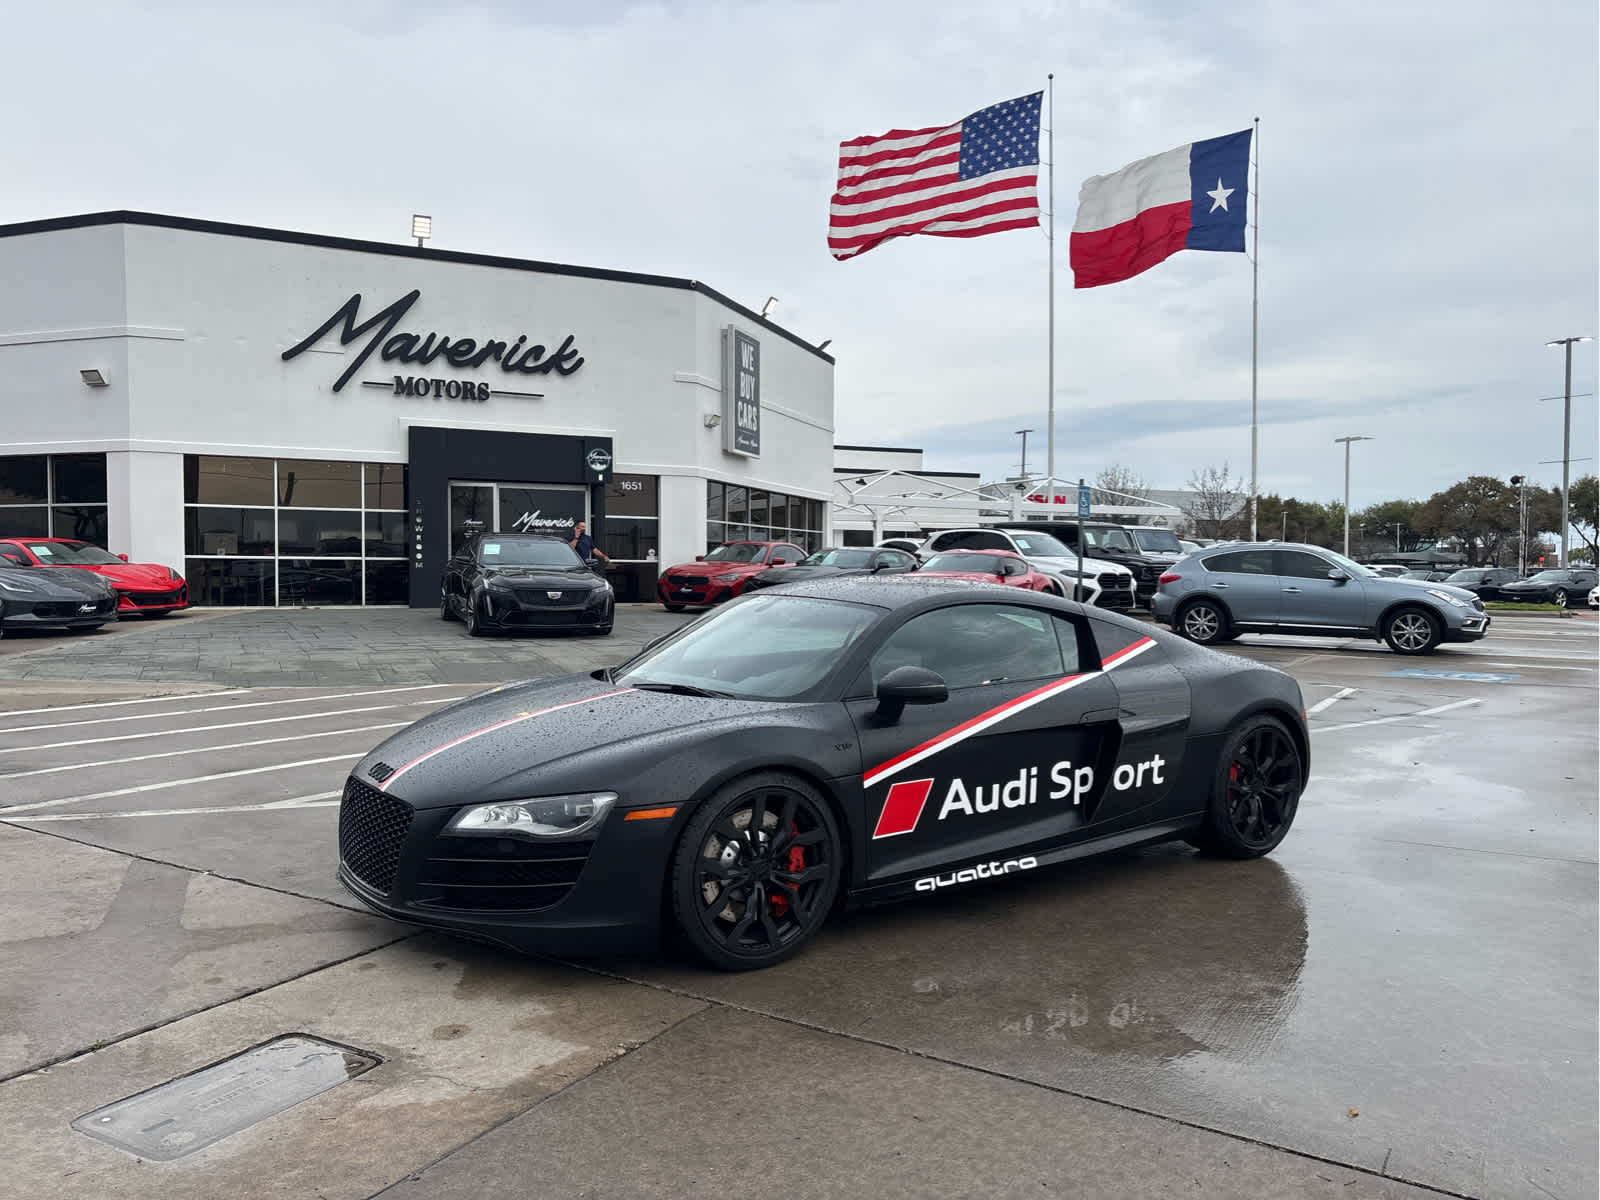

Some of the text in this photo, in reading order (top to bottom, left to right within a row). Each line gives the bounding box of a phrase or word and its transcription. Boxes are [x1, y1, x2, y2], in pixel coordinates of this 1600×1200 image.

[282, 289, 584, 393] Maverick
[741, 341, 755, 371] WE
[393, 376, 490, 401] MOTORS
[741, 372, 755, 401] BUY
[738, 401, 758, 432] CARS
[621, 481, 642, 491] 1651
[512, 509, 575, 533] Maverick
[939, 766, 1038, 820] Audi
[915, 856, 1038, 892] quattro
